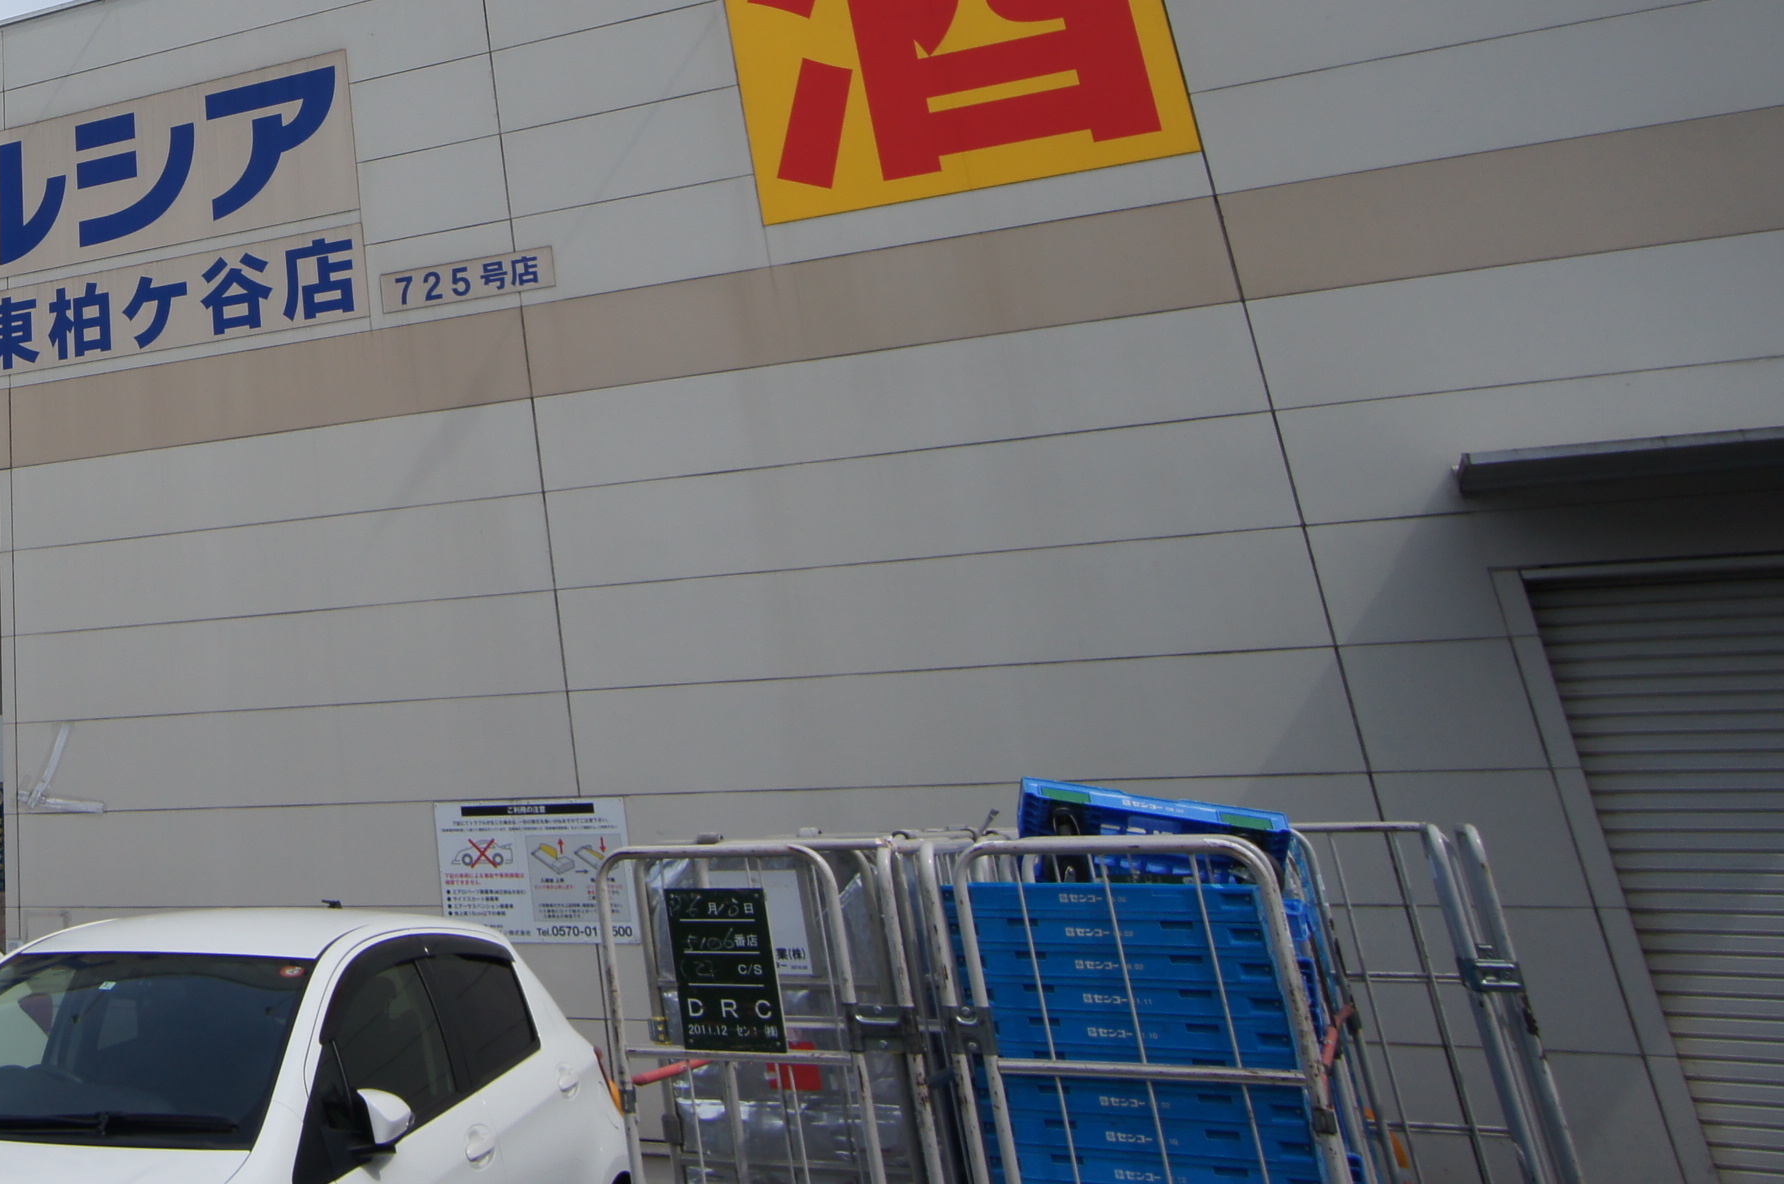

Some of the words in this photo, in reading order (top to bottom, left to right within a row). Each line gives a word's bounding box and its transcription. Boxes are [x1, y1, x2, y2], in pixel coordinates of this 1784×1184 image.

[393, 256, 541, 307] 725号店
[1132, 800, 1162, 809] センコー
[1069, 894, 1103, 902] センコー
[1077, 928, 1110, 936] センコー
[738, 963, 763, 975] C/S
[1086, 961, 1119, 969] センコー
[1094, 994, 1128, 1004] センコー
[1098, 1028, 1134, 1038] センコー
[1110, 1097, 1146, 1107] センコー
[1117, 1133, 1153, 1143] センコー
[1126, 1170, 1162, 1182] センコー
